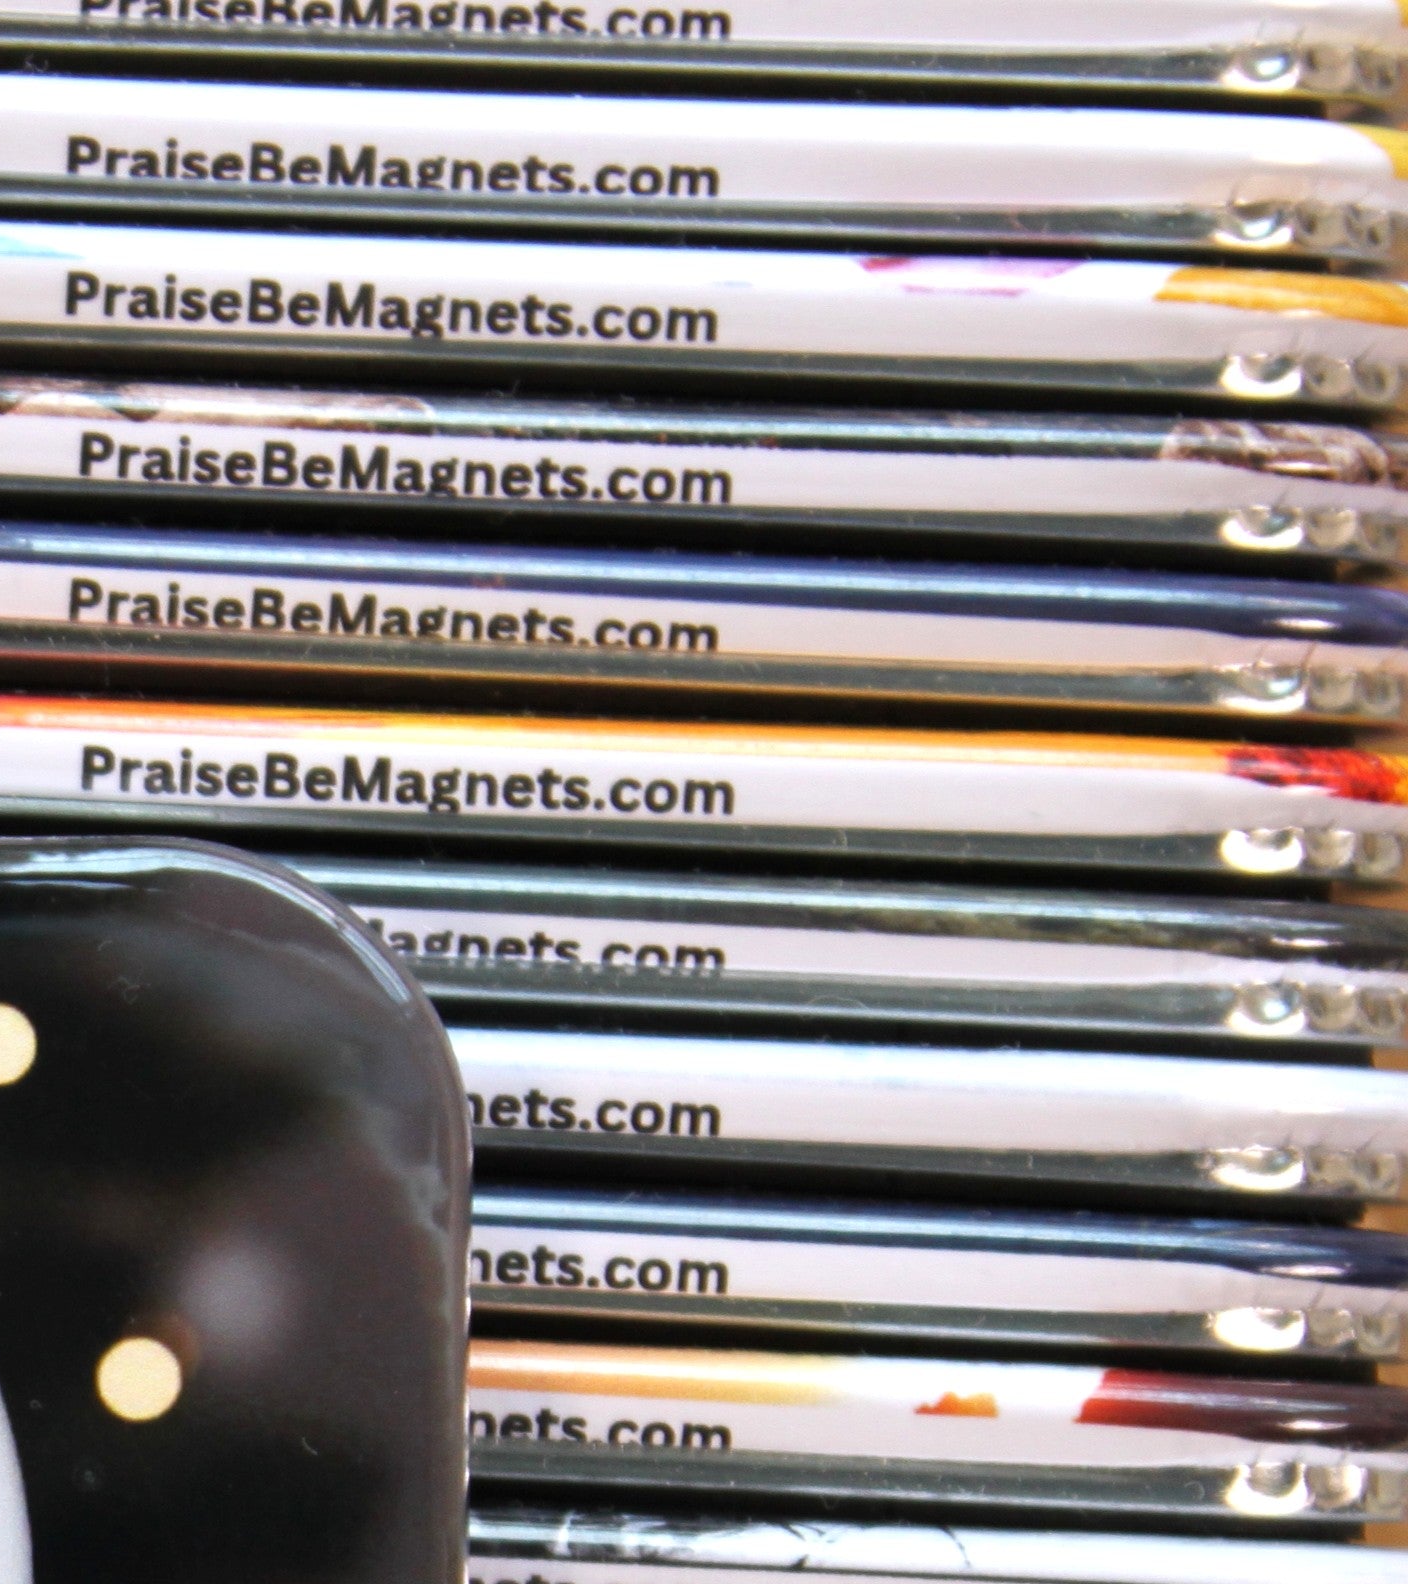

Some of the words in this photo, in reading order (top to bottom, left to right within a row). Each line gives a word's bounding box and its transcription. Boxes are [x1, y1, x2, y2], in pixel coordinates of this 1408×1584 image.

[67, 136, 720, 197] PraiseBeMagnets.com
[65, 271, 718, 342] PraiseBeMagnets.com
[79, 431, 732, 504] PraiseBeMagnets.com
[70, 577, 720, 651] PraiseBeMagnets.com
[81, 746, 735, 816] PraiseBeMagnets.com
